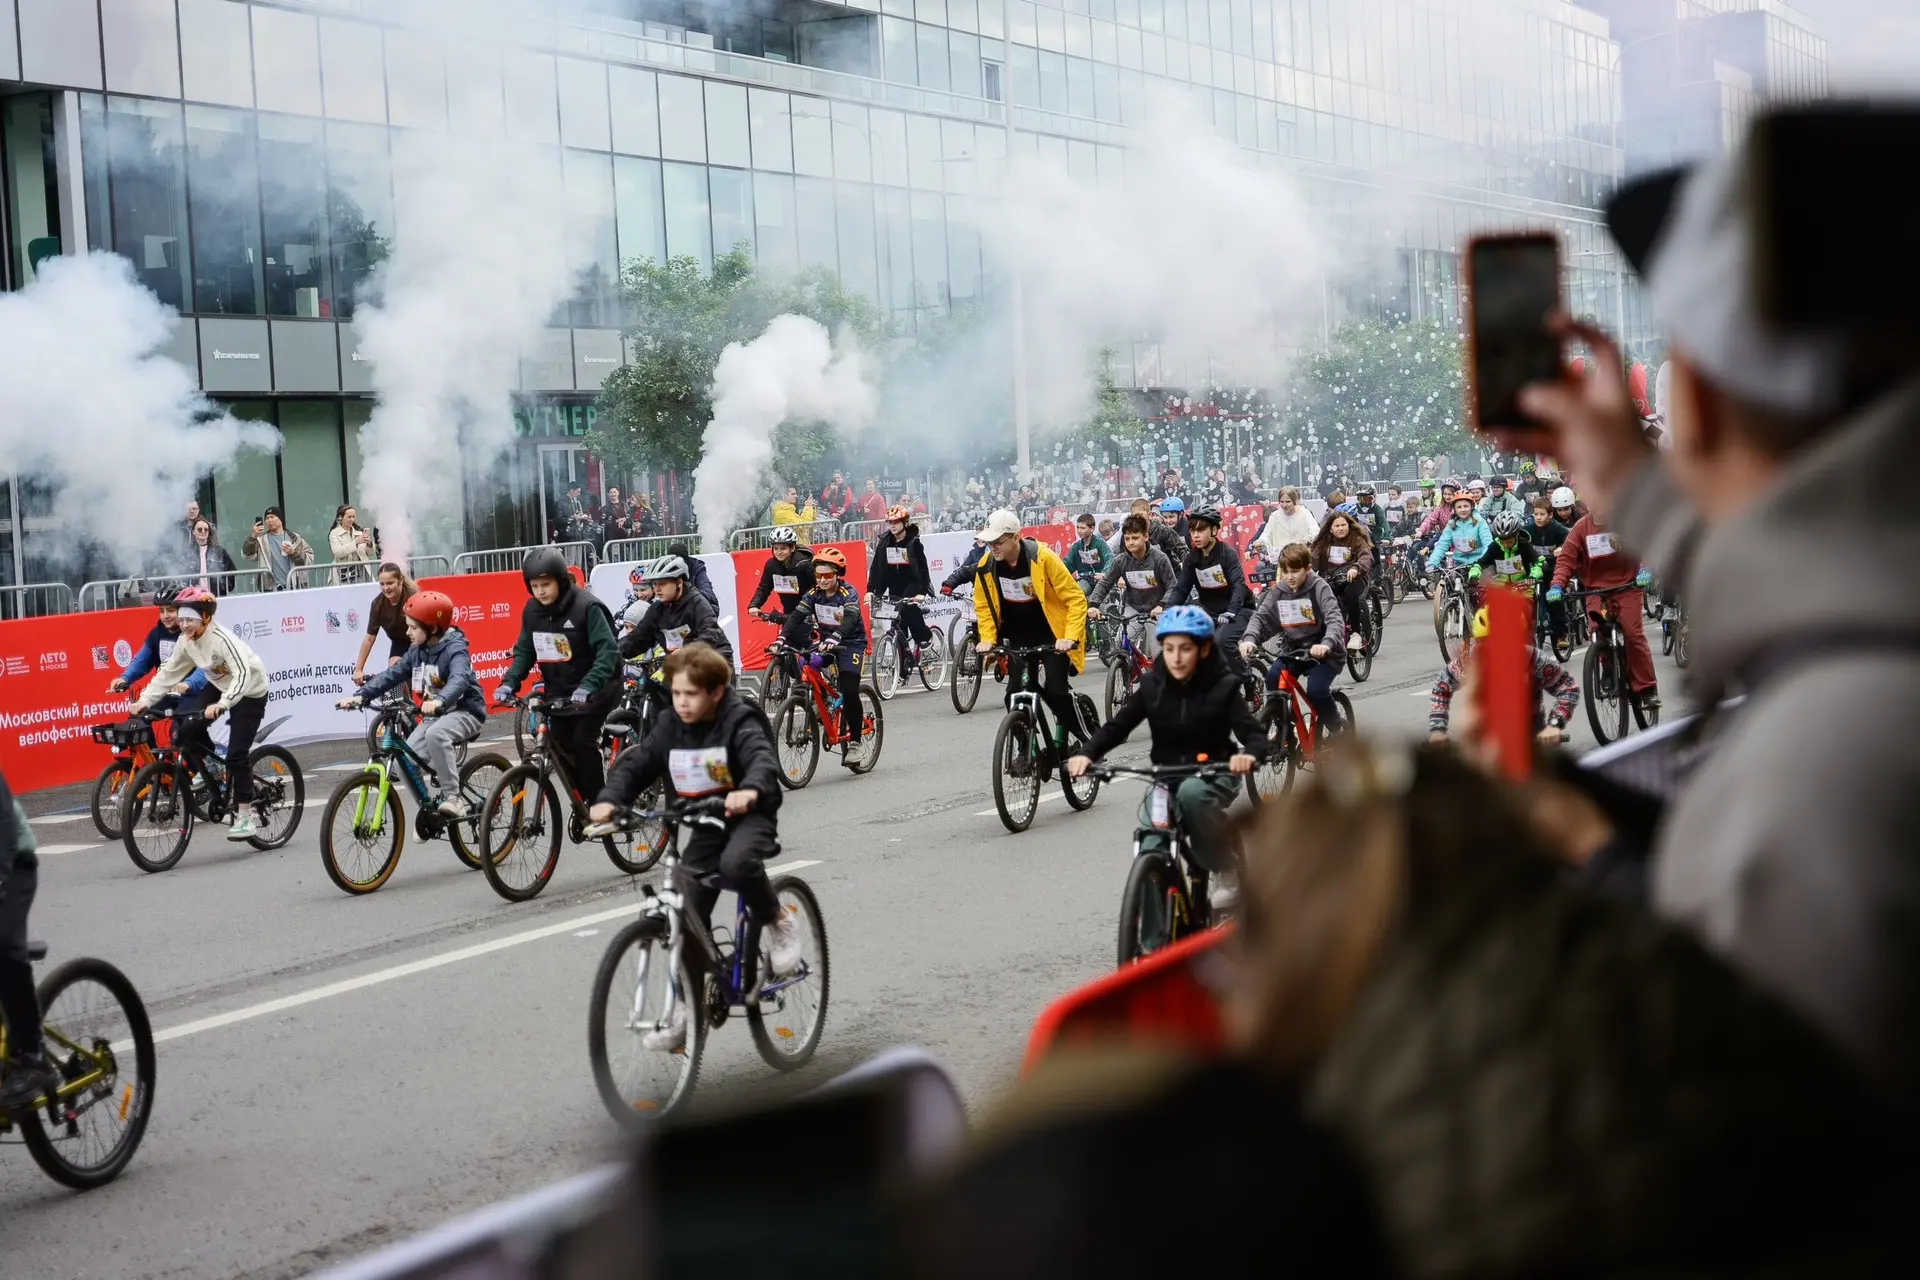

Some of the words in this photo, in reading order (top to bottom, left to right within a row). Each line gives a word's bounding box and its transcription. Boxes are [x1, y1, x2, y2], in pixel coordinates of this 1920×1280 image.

[491, 602, 510, 612] ЛЕТО
[281, 616, 305, 627] ЛЕТО
[40, 652, 67, 664] ЛЕТО
[852, 653, 860, 665] 5
[267, 664, 313, 683] ковский
[267, 683, 343, 702] елофестиваль
[0, 703, 79, 729] Московский
[82, 697, 131, 718] детский
